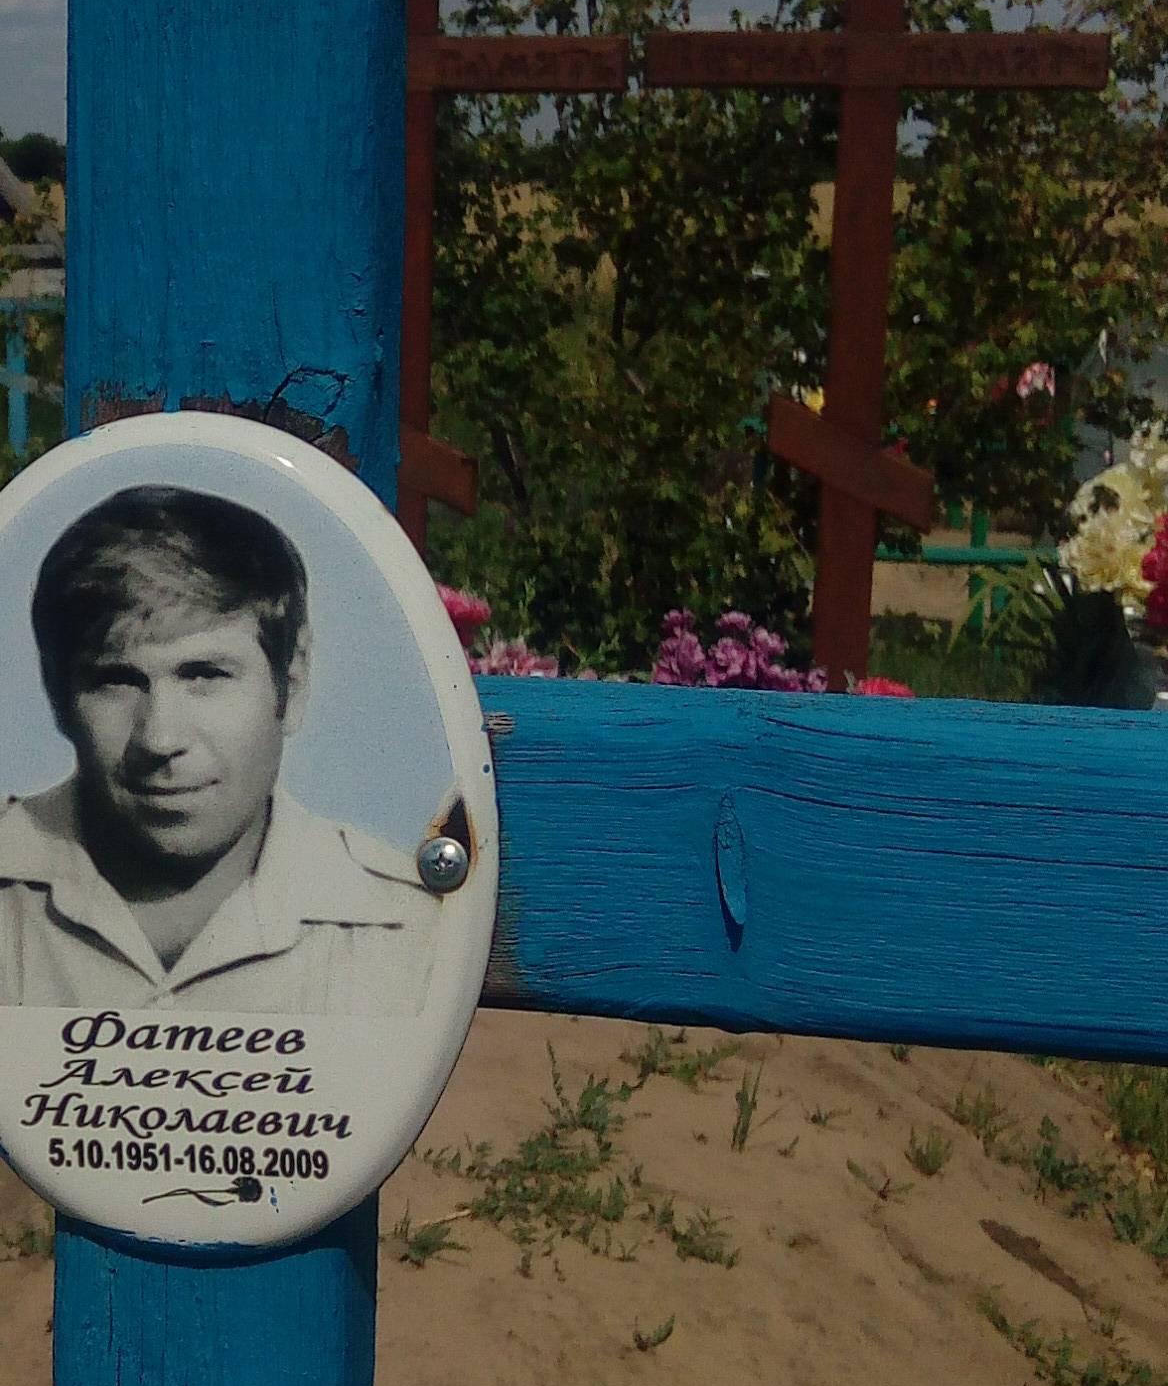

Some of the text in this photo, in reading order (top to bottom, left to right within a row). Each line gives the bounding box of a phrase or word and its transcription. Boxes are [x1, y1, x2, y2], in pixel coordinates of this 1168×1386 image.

[61, 1011, 306, 1055] Фатеев
[39, 1058, 315, 1098] Алексей
[20, 1093, 353, 1140] Николаевич
[48, 1138, 330, 1179] 5.10.1951-16.08.2009
